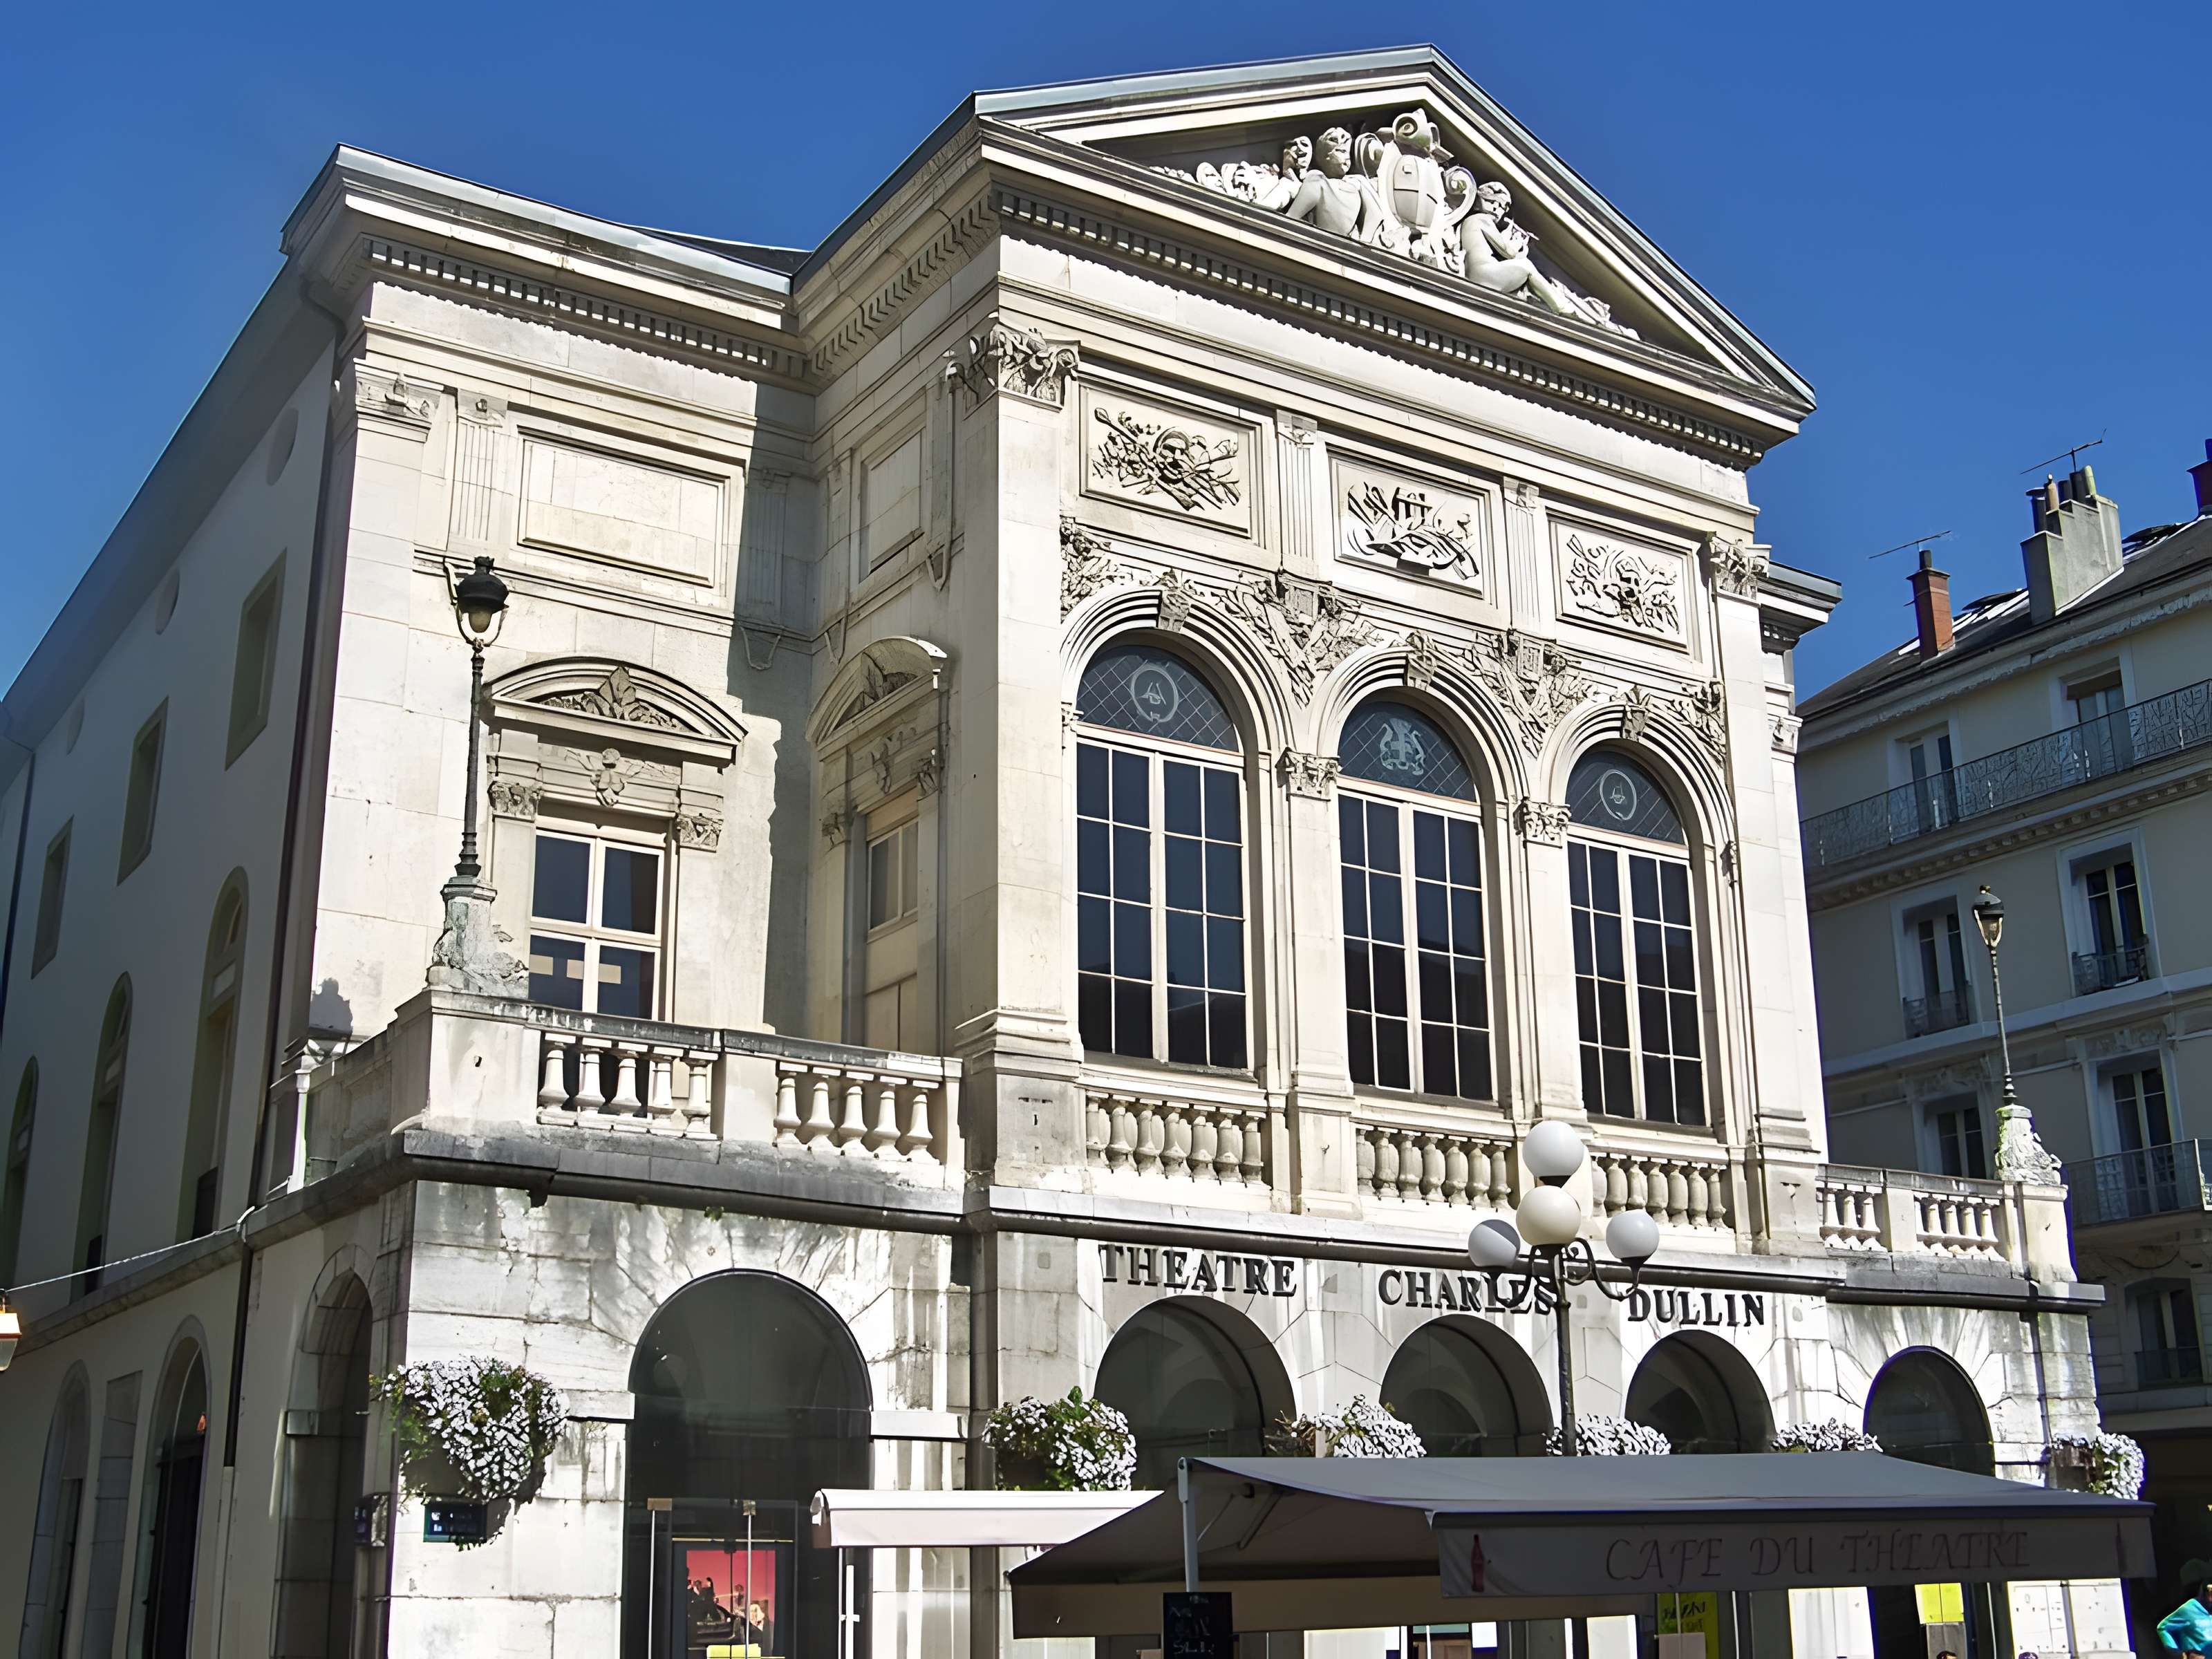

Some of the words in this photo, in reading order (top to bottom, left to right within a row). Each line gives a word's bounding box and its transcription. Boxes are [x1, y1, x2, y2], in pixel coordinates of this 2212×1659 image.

[1098, 1244, 1297, 1297] THEATRE
[1626, 1288, 1764, 1327] DULLIN
[1606, 1538, 1723, 1588] CAFE
[1750, 1537, 1815, 1575] DU
[1840, 1528, 2030, 1573] THEATRE
